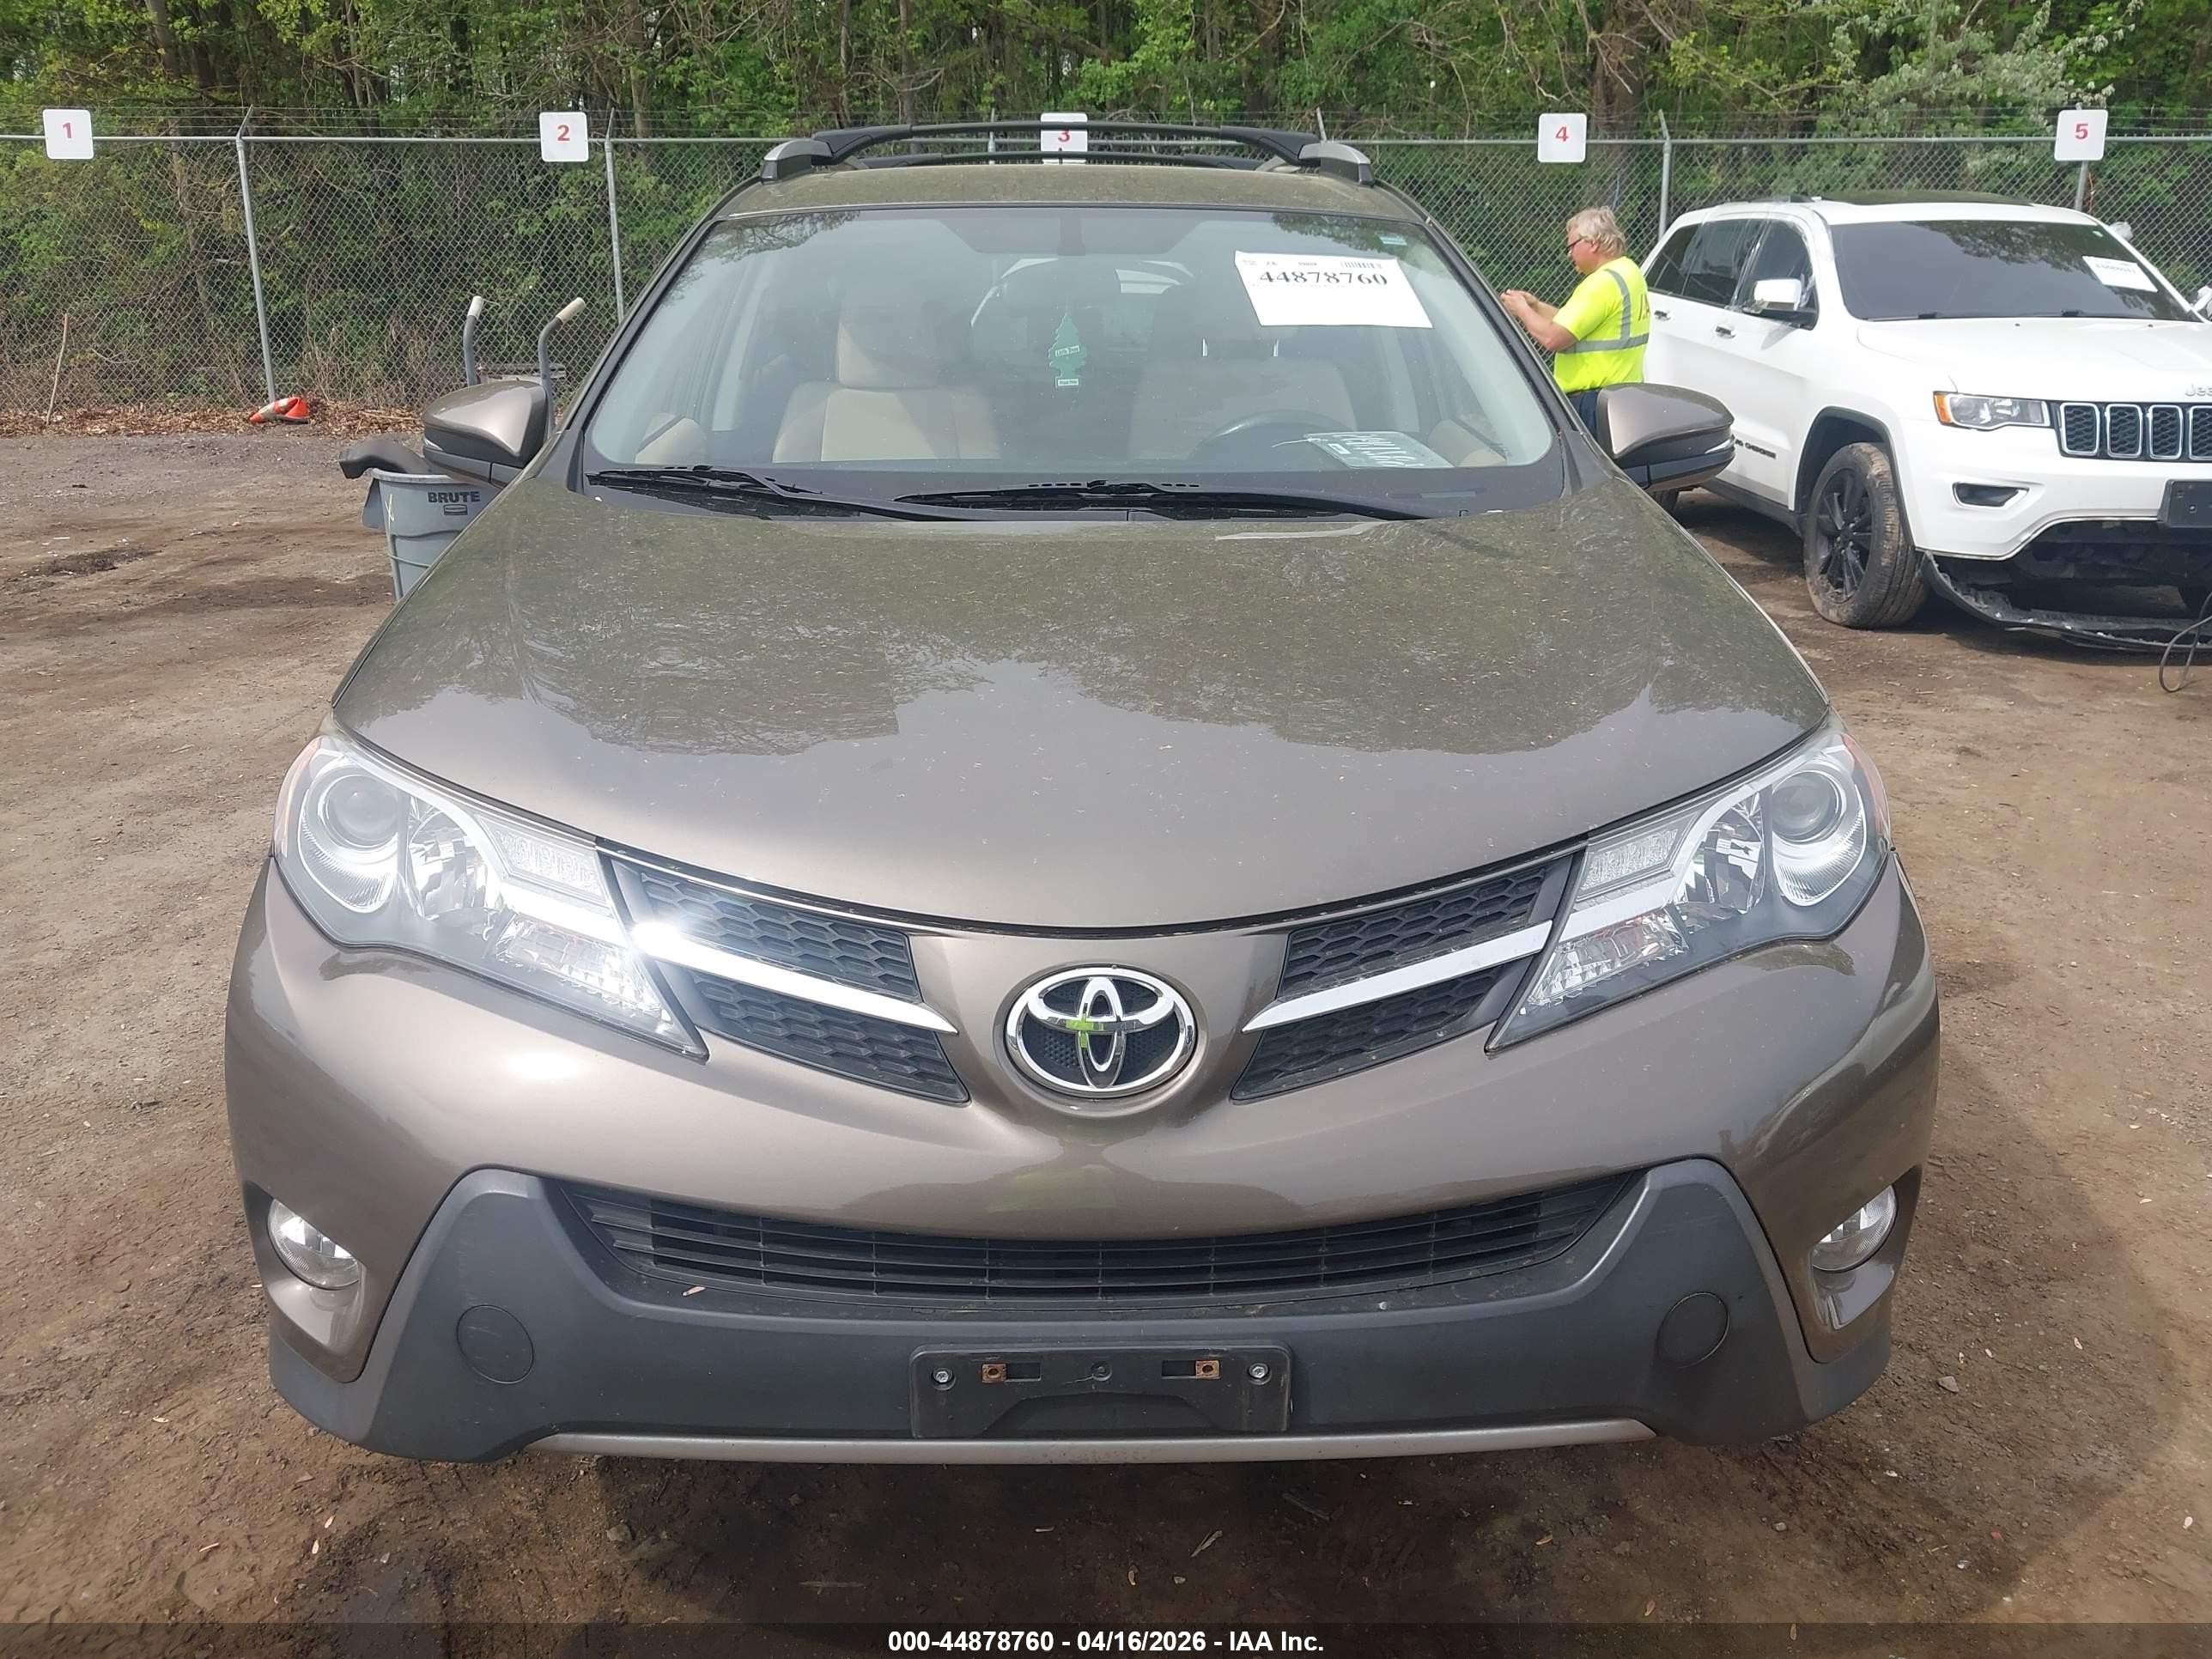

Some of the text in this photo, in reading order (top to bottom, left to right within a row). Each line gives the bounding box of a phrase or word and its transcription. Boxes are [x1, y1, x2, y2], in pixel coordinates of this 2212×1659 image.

[63, 123, 72, 138] 1
[557, 125, 570, 142] 2
[1058, 129, 1071, 143] 3
[1555, 126, 1569, 142] 4
[2075, 123, 2088, 140] 5
[1260, 270, 1388, 285] 44878760
[428, 491, 481, 503] BRUTE
